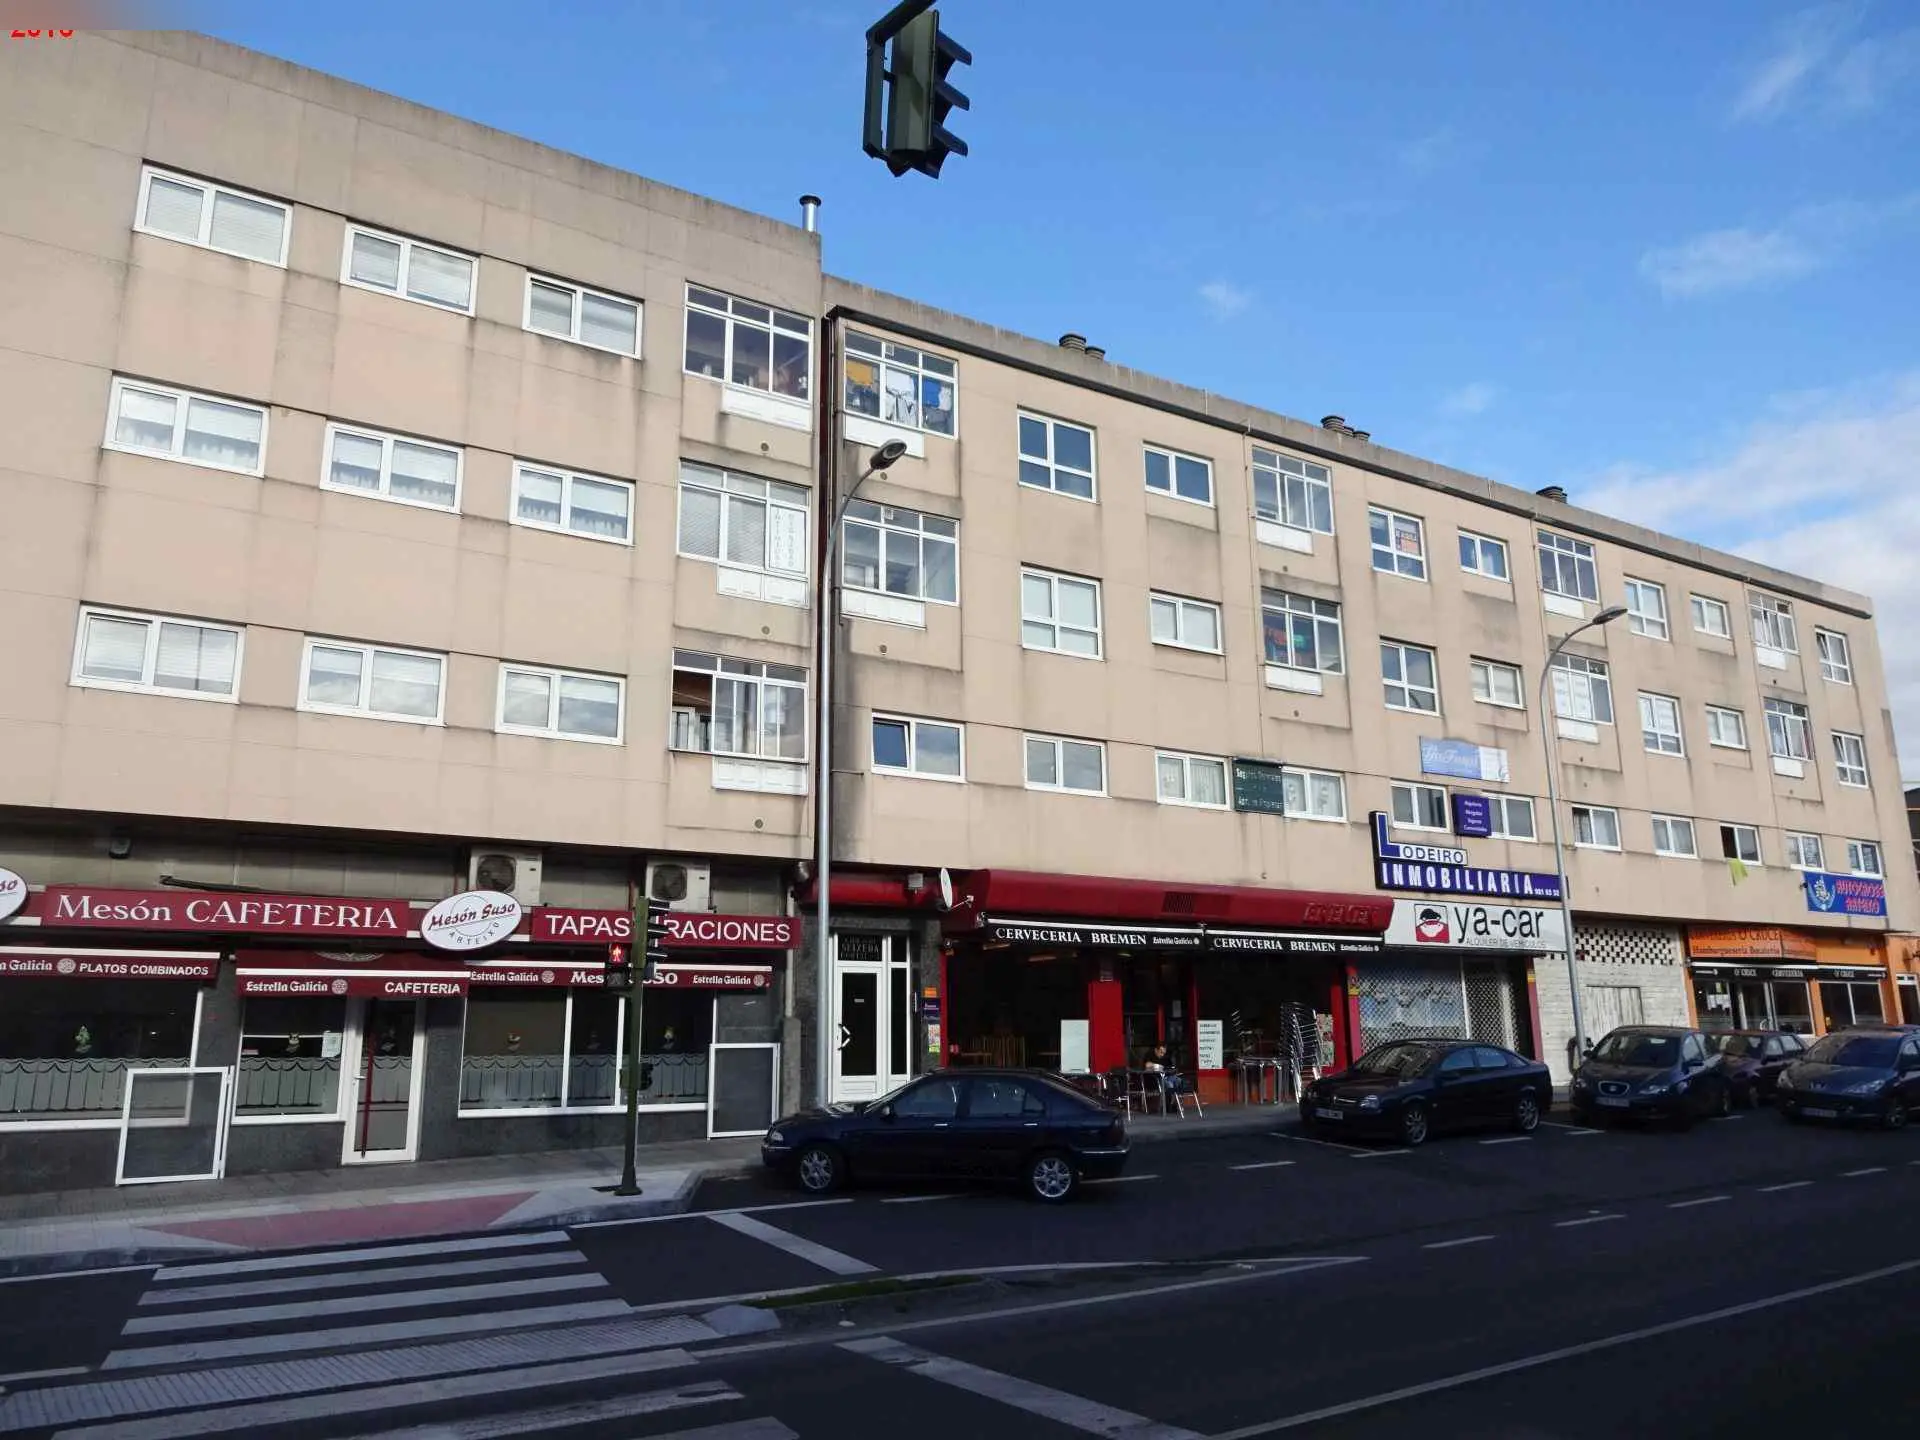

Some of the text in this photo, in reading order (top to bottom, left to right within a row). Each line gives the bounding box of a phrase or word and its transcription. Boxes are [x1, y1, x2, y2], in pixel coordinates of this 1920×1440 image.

[1381, 862, 1534, 895] INMOBILIARIA
[55, 894, 398, 929] Mesón CAFETERIA
[428, 906, 477, 931] Mesón
[545, 914, 791, 942] TAPAS RACIONES
[1454, 906, 1545, 944] ya-car
[996, 927, 1082, 944] CERVECERIA
[1091, 932, 1147, 945] BREMEN
[1213, 937, 1283, 950] CERVECERIA
[1290, 941, 1336, 952] BREMEN
[9, 959, 53, 971] Galicia
[79, 963, 128, 974] PLATOS
[131, 965, 209, 976] COMBINADOS
[470, 971, 506, 982] Estrella
[507, 972, 539, 982] Galicia
[570, 970, 605, 985] Mes
[692, 975, 723, 984] Estrella
[723, 975, 751, 985] Galicia
[246, 980, 461, 994] Estrella Galicia CAFETERIA
